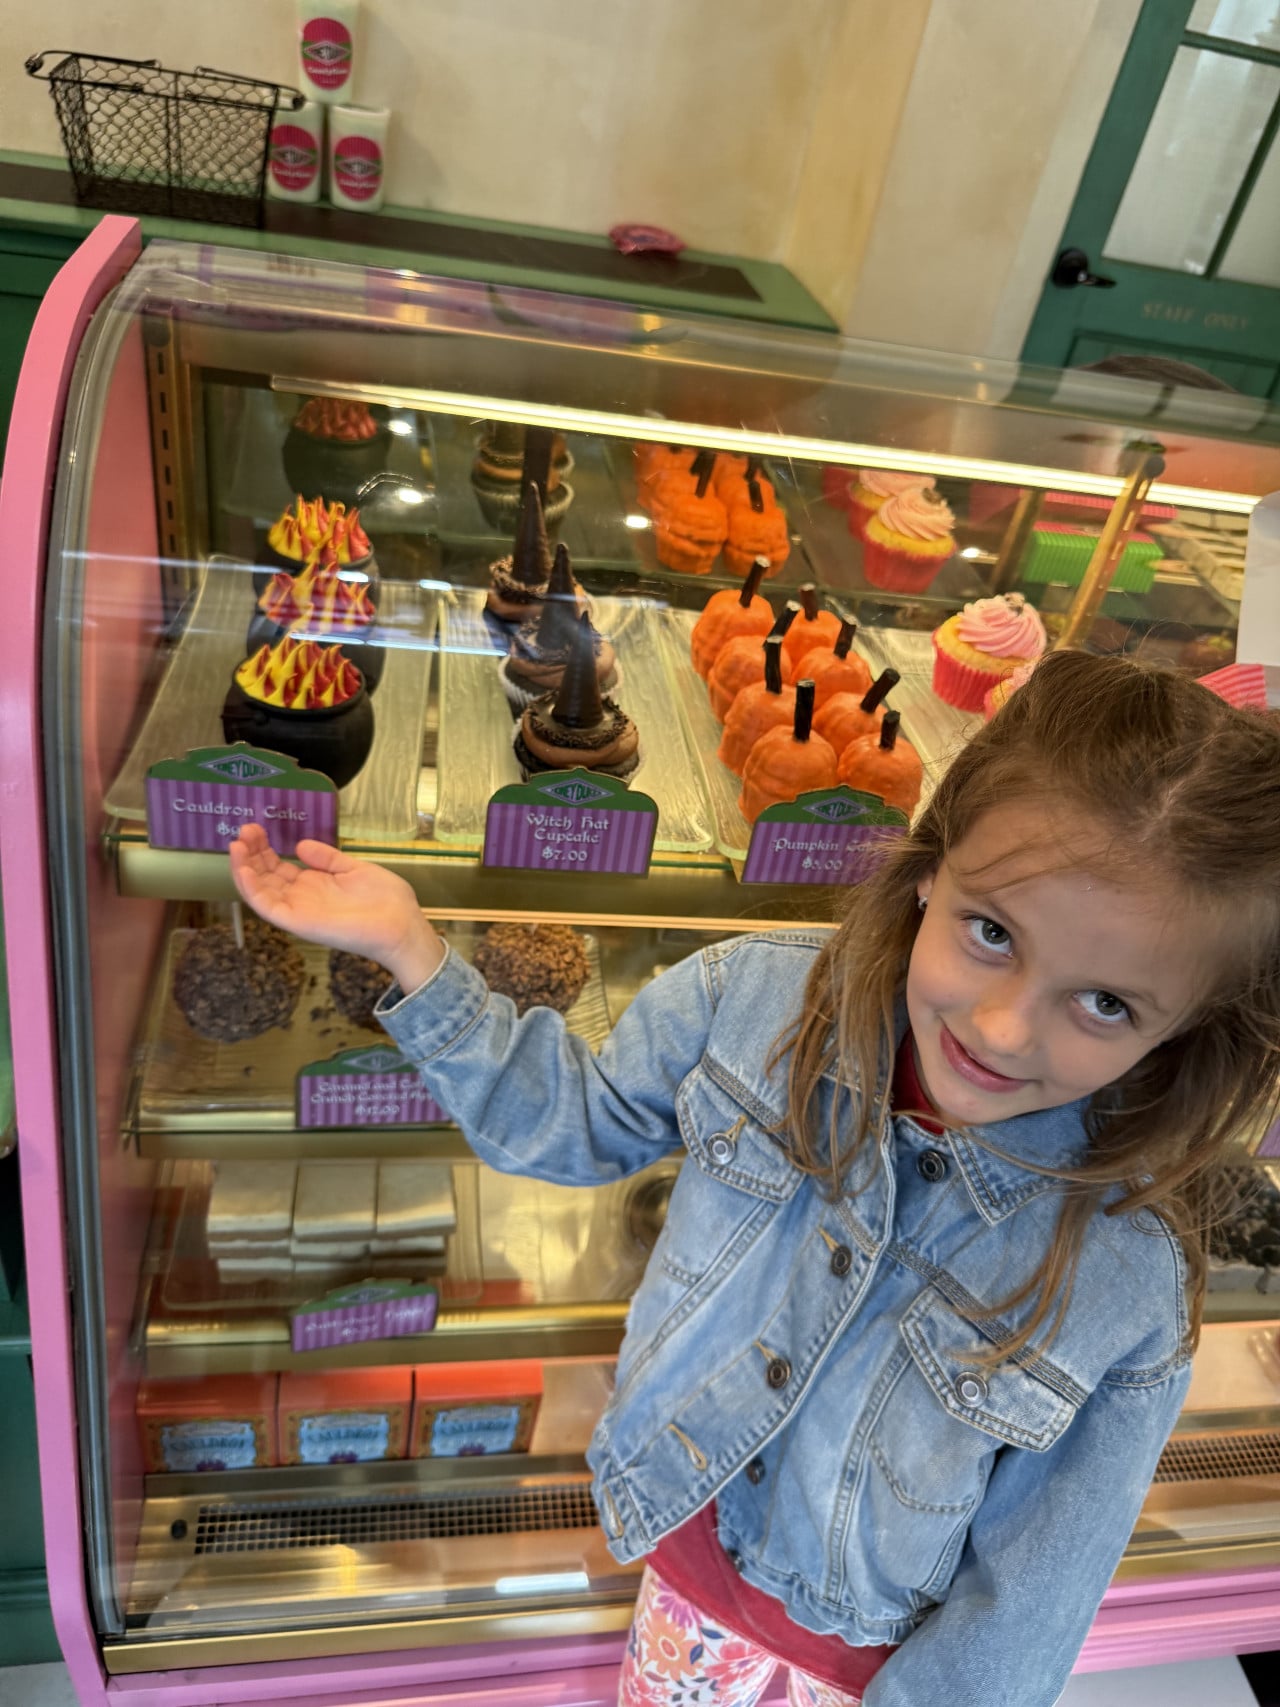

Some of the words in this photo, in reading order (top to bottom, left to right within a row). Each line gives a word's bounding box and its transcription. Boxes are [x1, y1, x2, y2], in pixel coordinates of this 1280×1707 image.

[172, 798, 254, 817] Cauldron
[263, 805, 309, 822] Cake
[526, 812, 573, 831] Witch
[581, 816, 610, 831] Hat
[534, 828, 600, 844] Cupcake
[772, 837, 840, 853] Pumpkin
[542, 846, 588, 862] $7.00
